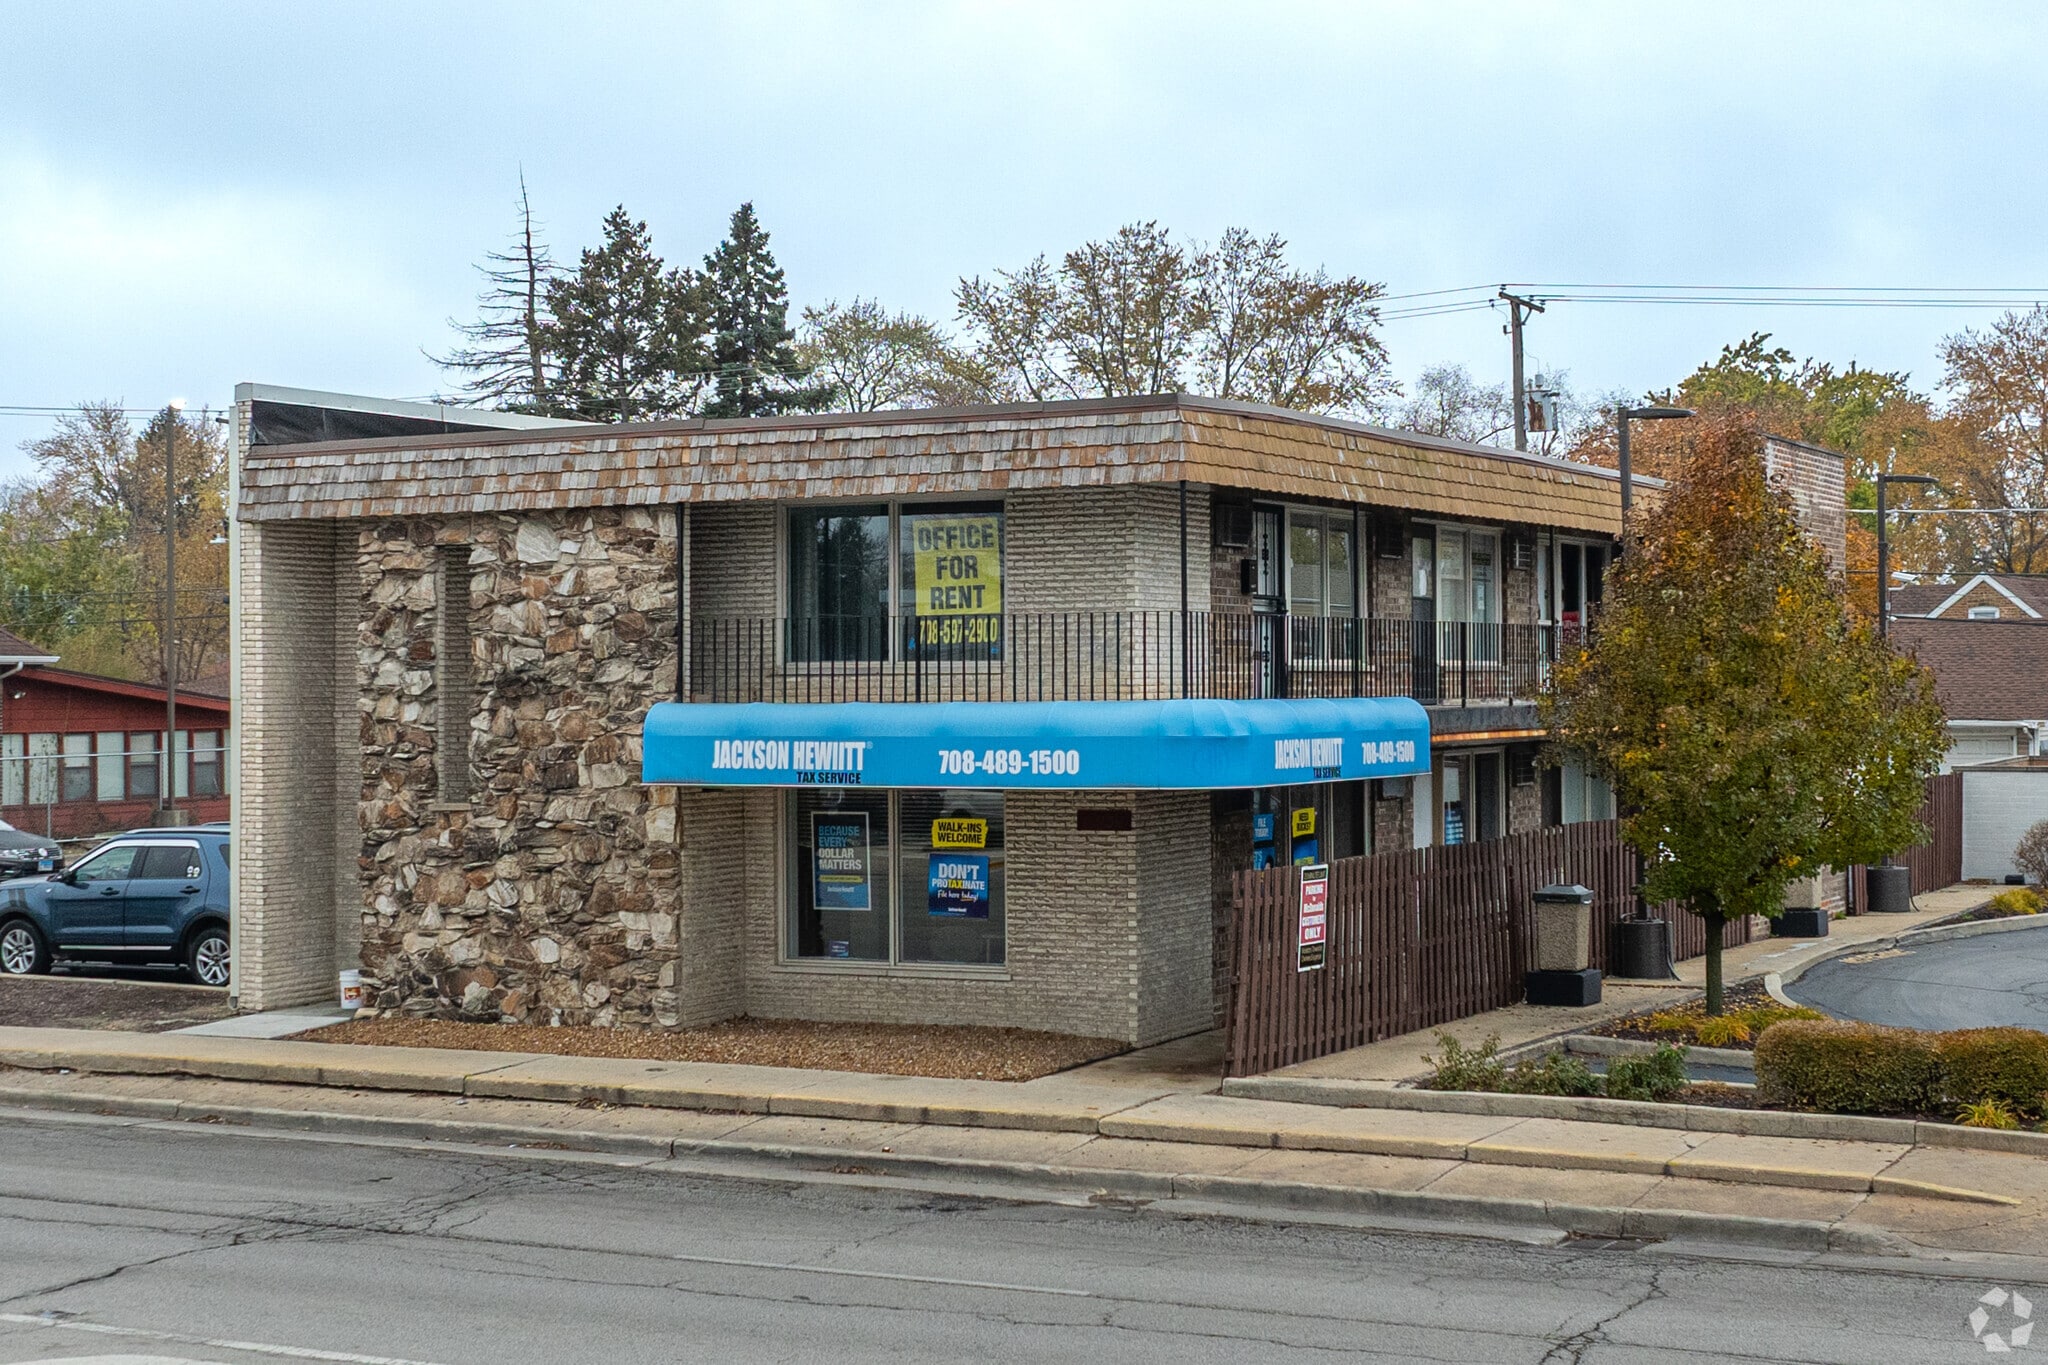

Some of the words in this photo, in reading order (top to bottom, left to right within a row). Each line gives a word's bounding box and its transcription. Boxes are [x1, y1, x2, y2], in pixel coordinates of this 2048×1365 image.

[917, 524, 994, 551] OFFICE
[936, 554, 979, 580] FOR
[930, 584, 986, 610] RENT
[712, 740, 790, 770] JACKSON
[1275, 739, 1311, 769] JACKSON
[1361, 740, 1415, 765] 708-489-1500
[938, 749, 1080, 775] 708-489-1500
[796, 771, 816, 784] TAX
[818, 772, 861, 784] SERVICE
[818, 825, 860, 837] BECAUSE
[937, 821, 982, 833] WALK-INS
[818, 836, 847, 848] EVERY
[937, 832, 982, 844] WELCOME
[818, 847, 854, 859] DOLLAR
[818, 859, 862, 871] MATTERS
[938, 862, 980, 881] DON'T
[937, 889, 948, 899] File
[948, 889, 960, 899] here
